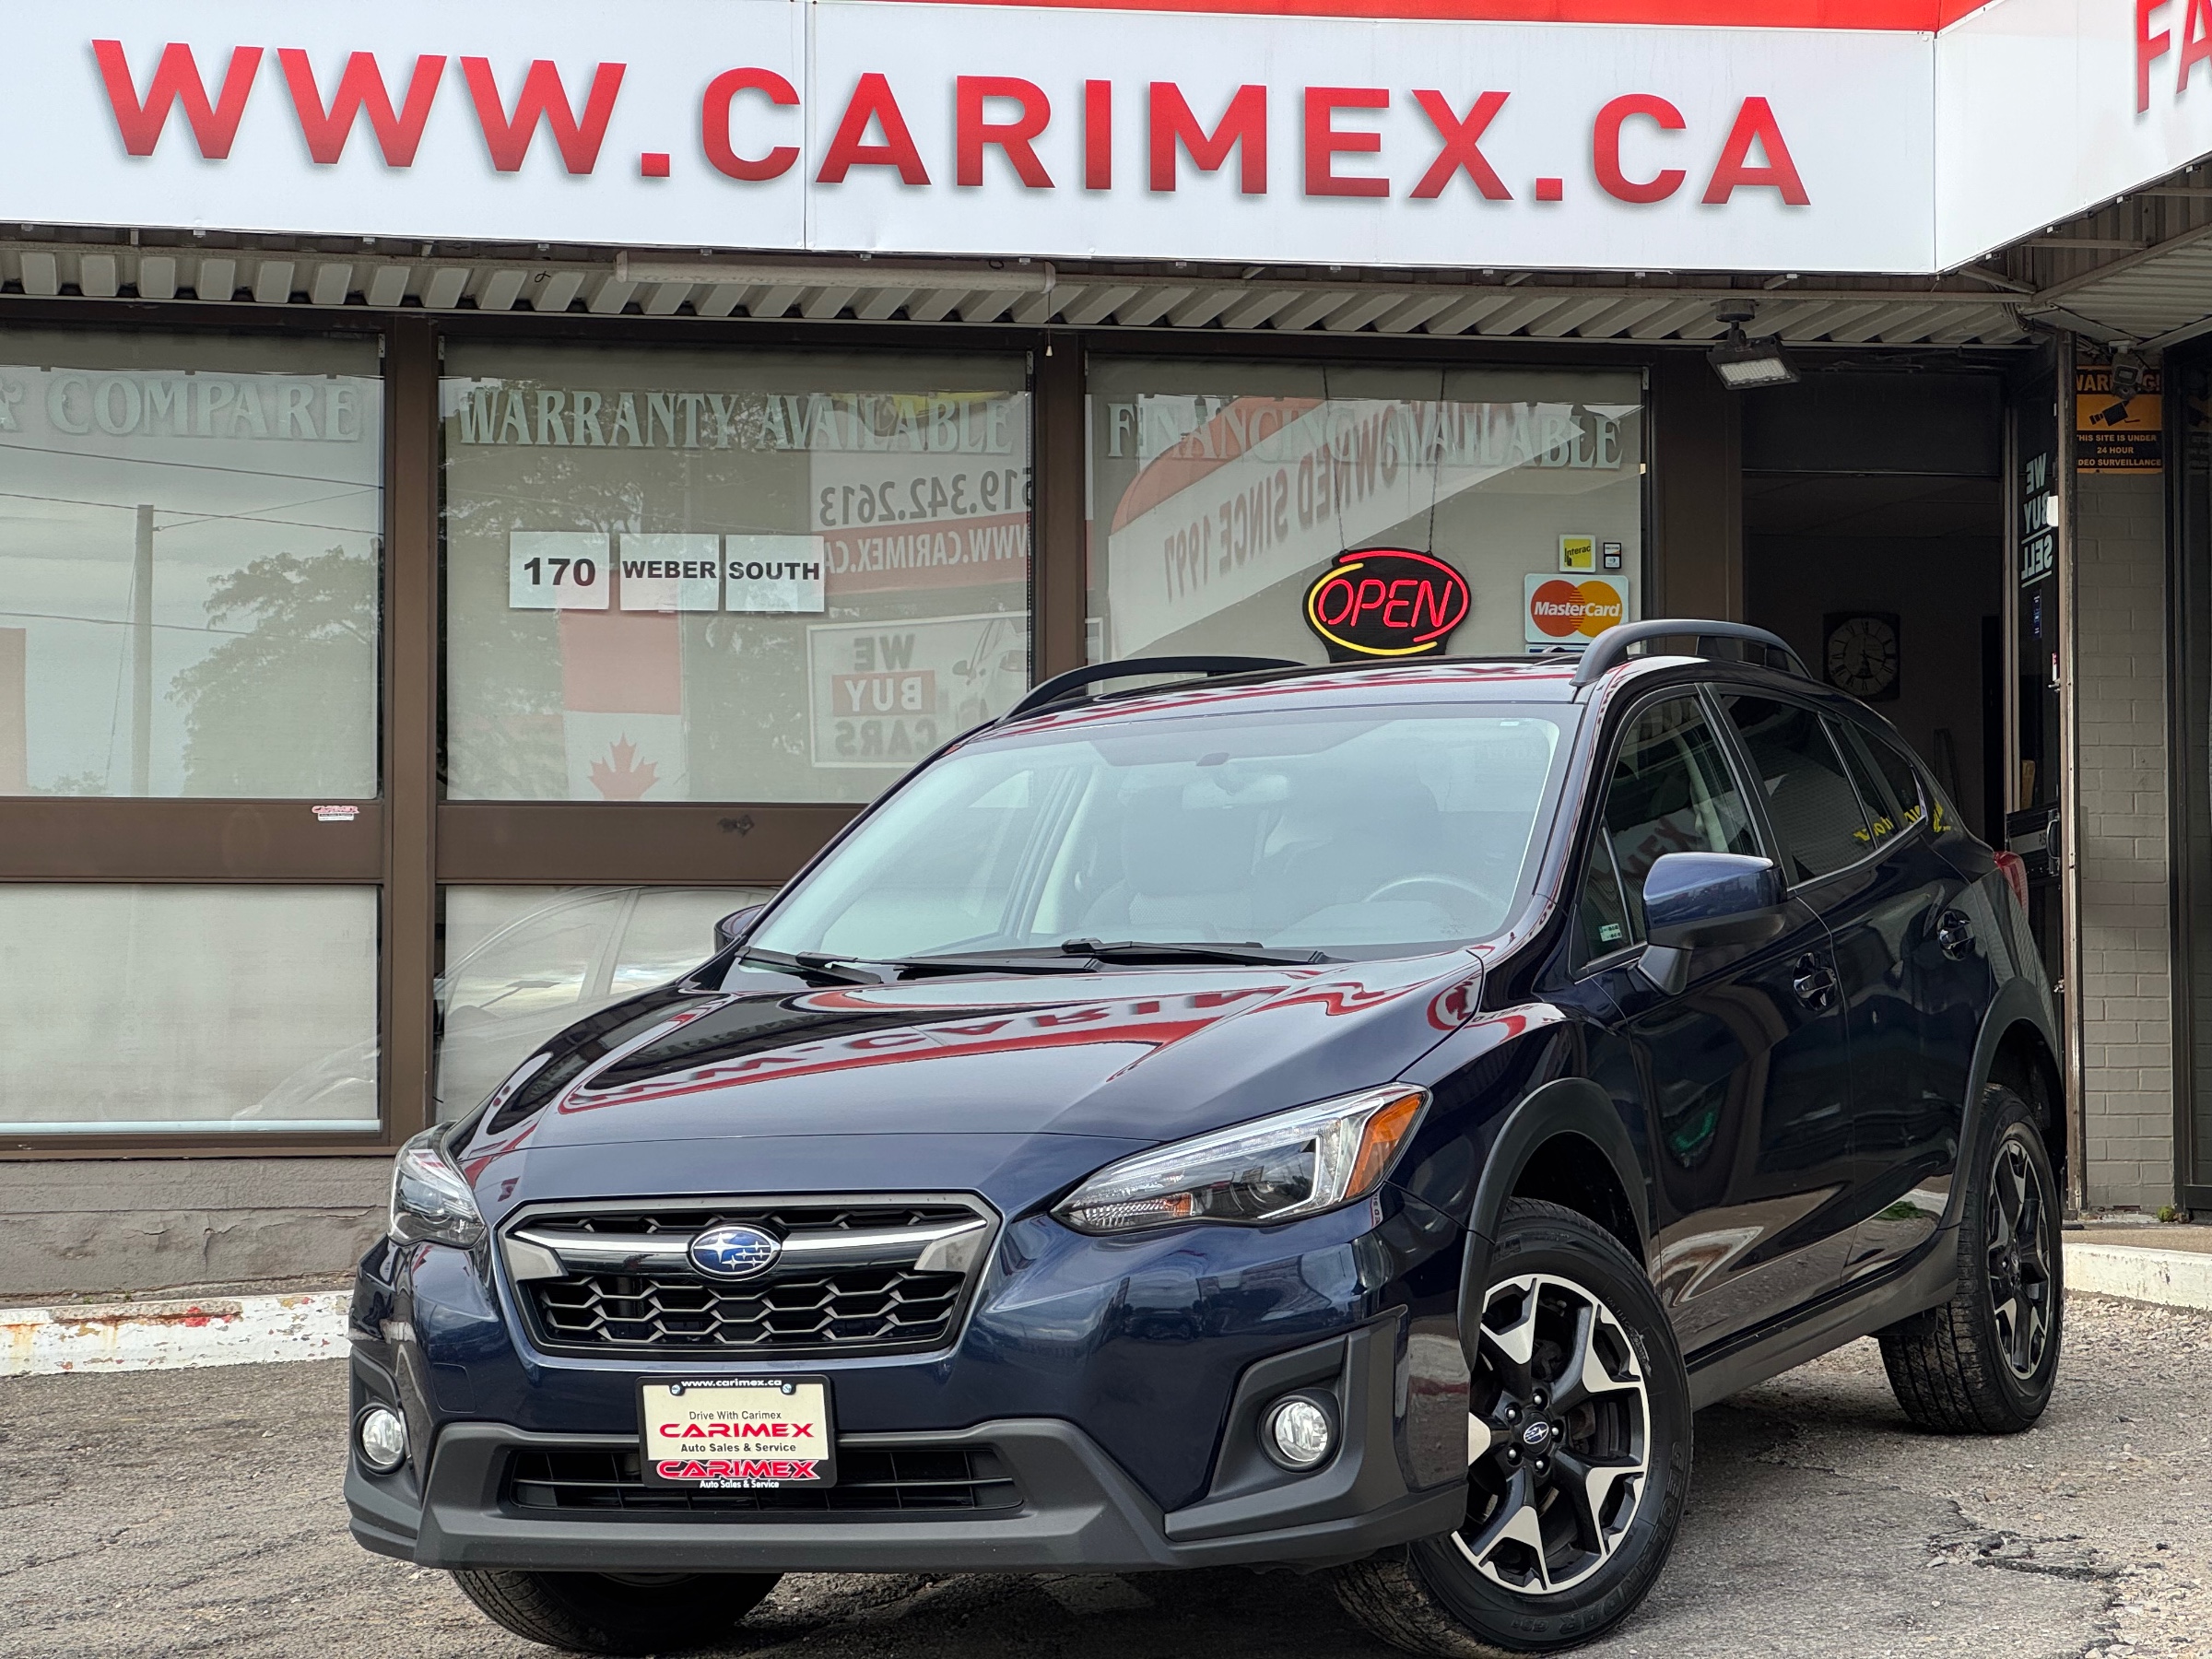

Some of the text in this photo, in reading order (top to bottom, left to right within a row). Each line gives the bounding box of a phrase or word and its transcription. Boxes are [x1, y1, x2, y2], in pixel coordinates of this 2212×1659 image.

[91, 39, 1811, 206] WWW.CARIMEX.CA
[2077, 373, 2160, 392] ARG!
[46, 374, 360, 441] COMPARE
[460, 386, 1013, 453] WARRANTY AVAILABLE
[1107, 402, 1355, 462] FINANCING
[1382, 406, 1623, 469] AVAILABLE
[2077, 434, 2157, 442] HIS SITE IS UNDER
[2109, 446, 2134, 454] HOUR
[1564, 544, 1592, 558] Interac
[523, 557, 820, 586] 170 WEBER SOUTH
[1317, 578, 1453, 629] OPEN
[1534, 601, 1621, 617] MasterCard
[681, 1378, 782, 1387] www.carimex.ca
[688, 1410, 782, 1420] Drive With Carimex
[659, 1422, 815, 1438] CARIMEX
[680, 1442, 797, 1453] Auto Sales & Service
[656, 1459, 821, 1480] CARIMEX
[700, 1479, 719, 1488] Auto
[720, 1479, 742, 1488] Sales
[751, 1479, 780, 1488] Service
